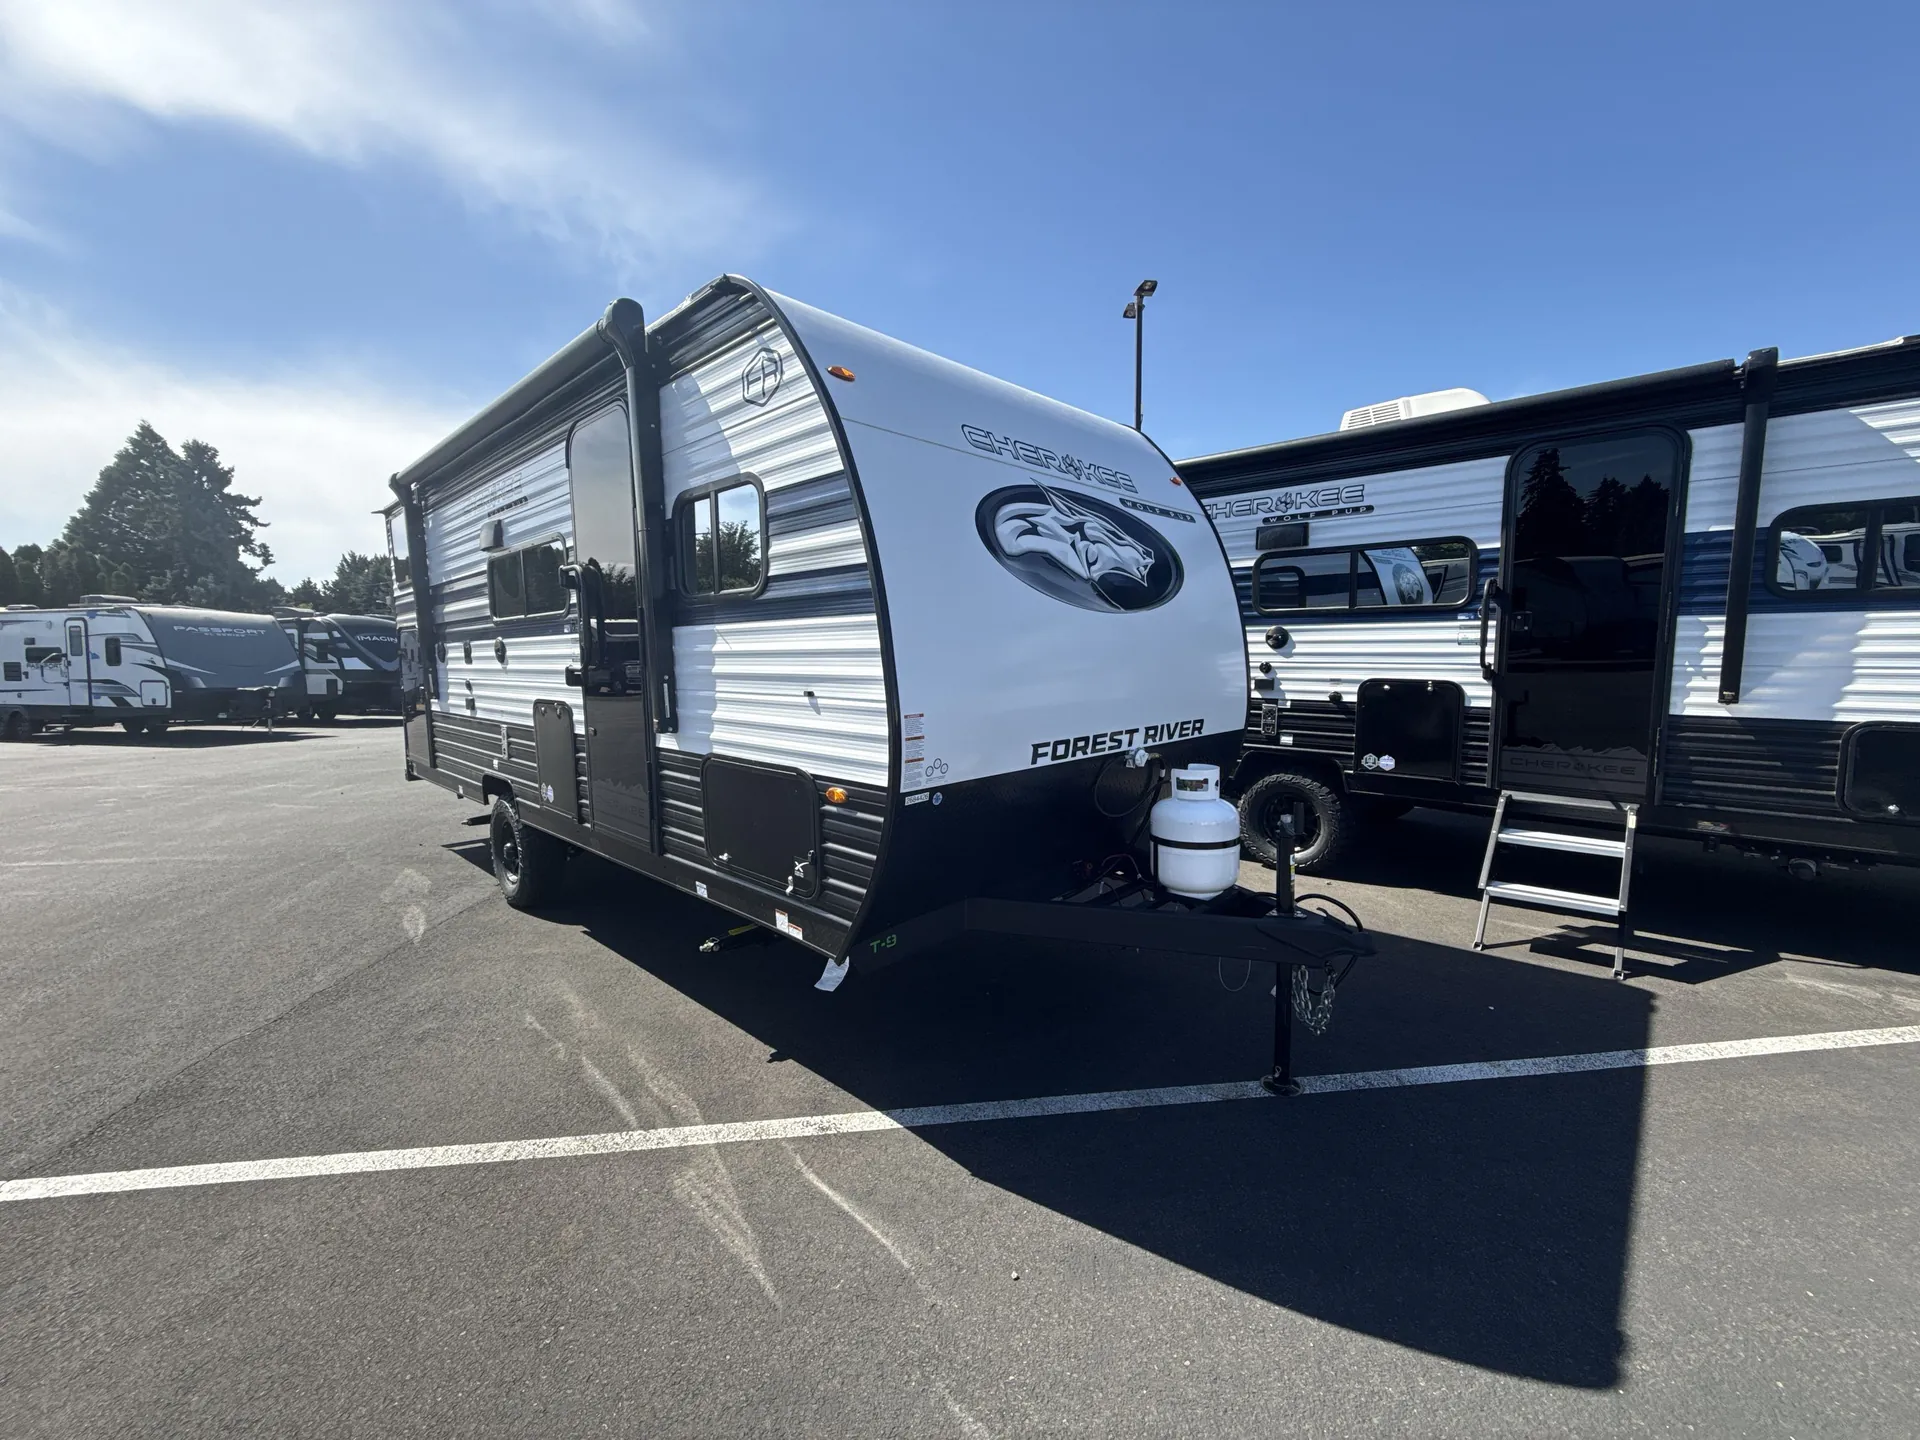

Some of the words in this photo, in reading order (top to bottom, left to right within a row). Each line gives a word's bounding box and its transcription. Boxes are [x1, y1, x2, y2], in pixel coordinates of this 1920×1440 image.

[1124, 499, 1161, 514] WOLF
[1168, 511, 1192, 521] PUP
[1269, 511, 1317, 523] WOLF
[1331, 506, 1368, 517] PUP
[172, 625, 266, 635] PASSPORT
[1030, 727, 1140, 766] FOREST
[1143, 718, 1205, 745] RIVER
